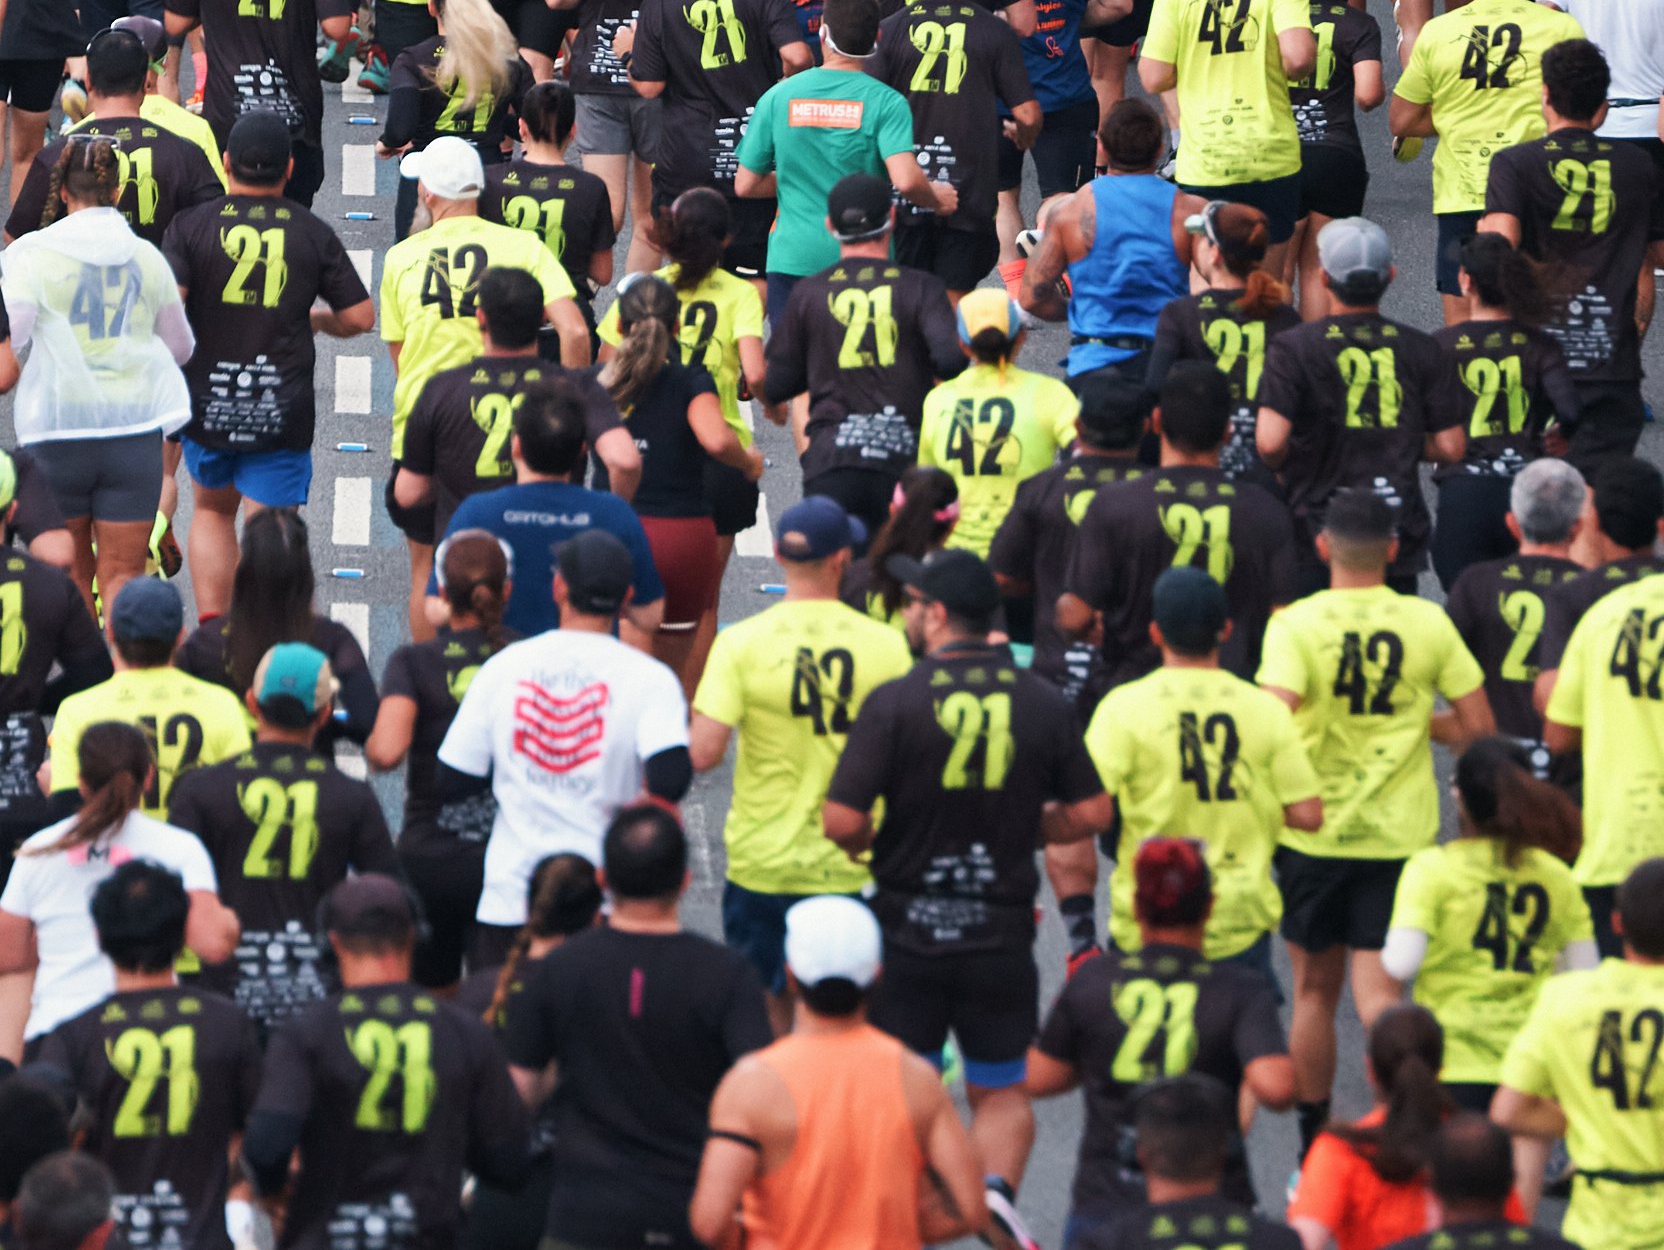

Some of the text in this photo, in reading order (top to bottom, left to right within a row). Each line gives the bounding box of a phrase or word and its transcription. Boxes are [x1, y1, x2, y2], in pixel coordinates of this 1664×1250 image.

[909, 21, 967, 95] 21
[1460, 23, 1523, 91] 42
[793, 104, 845, 118] METRUS
[503, 195, 566, 259] 21
[1549, 159, 1616, 235] 21
[69, 262, 142, 340] 42
[221, 224, 288, 309] 21
[421, 244, 489, 319] 42
[829, 286, 897, 369] 21
[1203, 319, 1265, 401] 21
[1338, 347, 1402, 429] 21
[1459, 356, 1529, 438] 21
[946, 397, 1015, 477] 42
[1159, 503, 1233, 587] 21
[1334, 630, 1404, 716] 42
[1500, 591, 1546, 682] 2
[791, 646, 855, 735] 42
[934, 692, 1014, 790] 21
[1179, 712, 1240, 802] 42
[237, 778, 319, 879] 21
[1473, 883, 1550, 973] 42
[1111, 979, 1198, 1084] 21
[1591, 1007, 1664, 1111] 42
[105, 1025, 198, 1138] 21
[346, 1019, 436, 1135] 21
